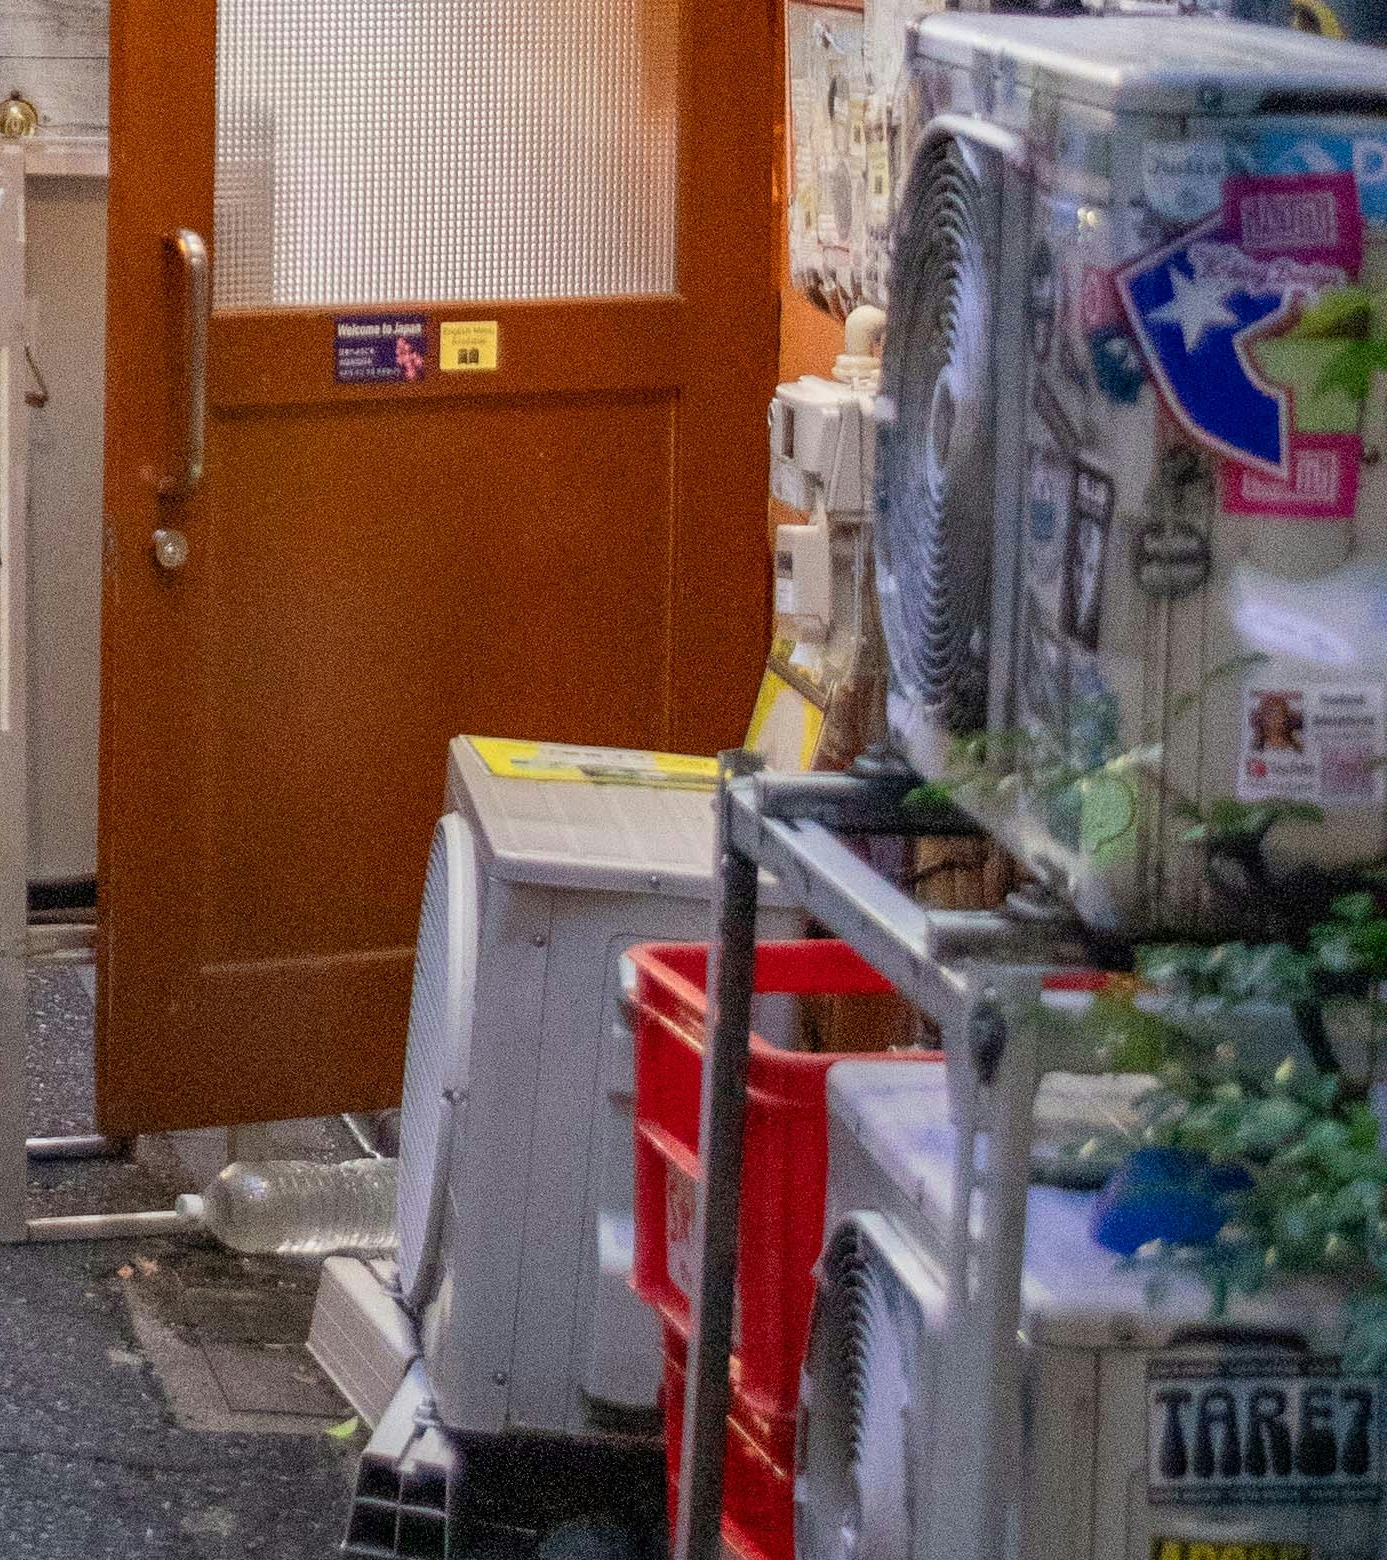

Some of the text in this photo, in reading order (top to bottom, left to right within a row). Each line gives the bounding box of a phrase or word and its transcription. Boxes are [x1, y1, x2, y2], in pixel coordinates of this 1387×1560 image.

[338, 322, 422, 337] Welcome to Japan
